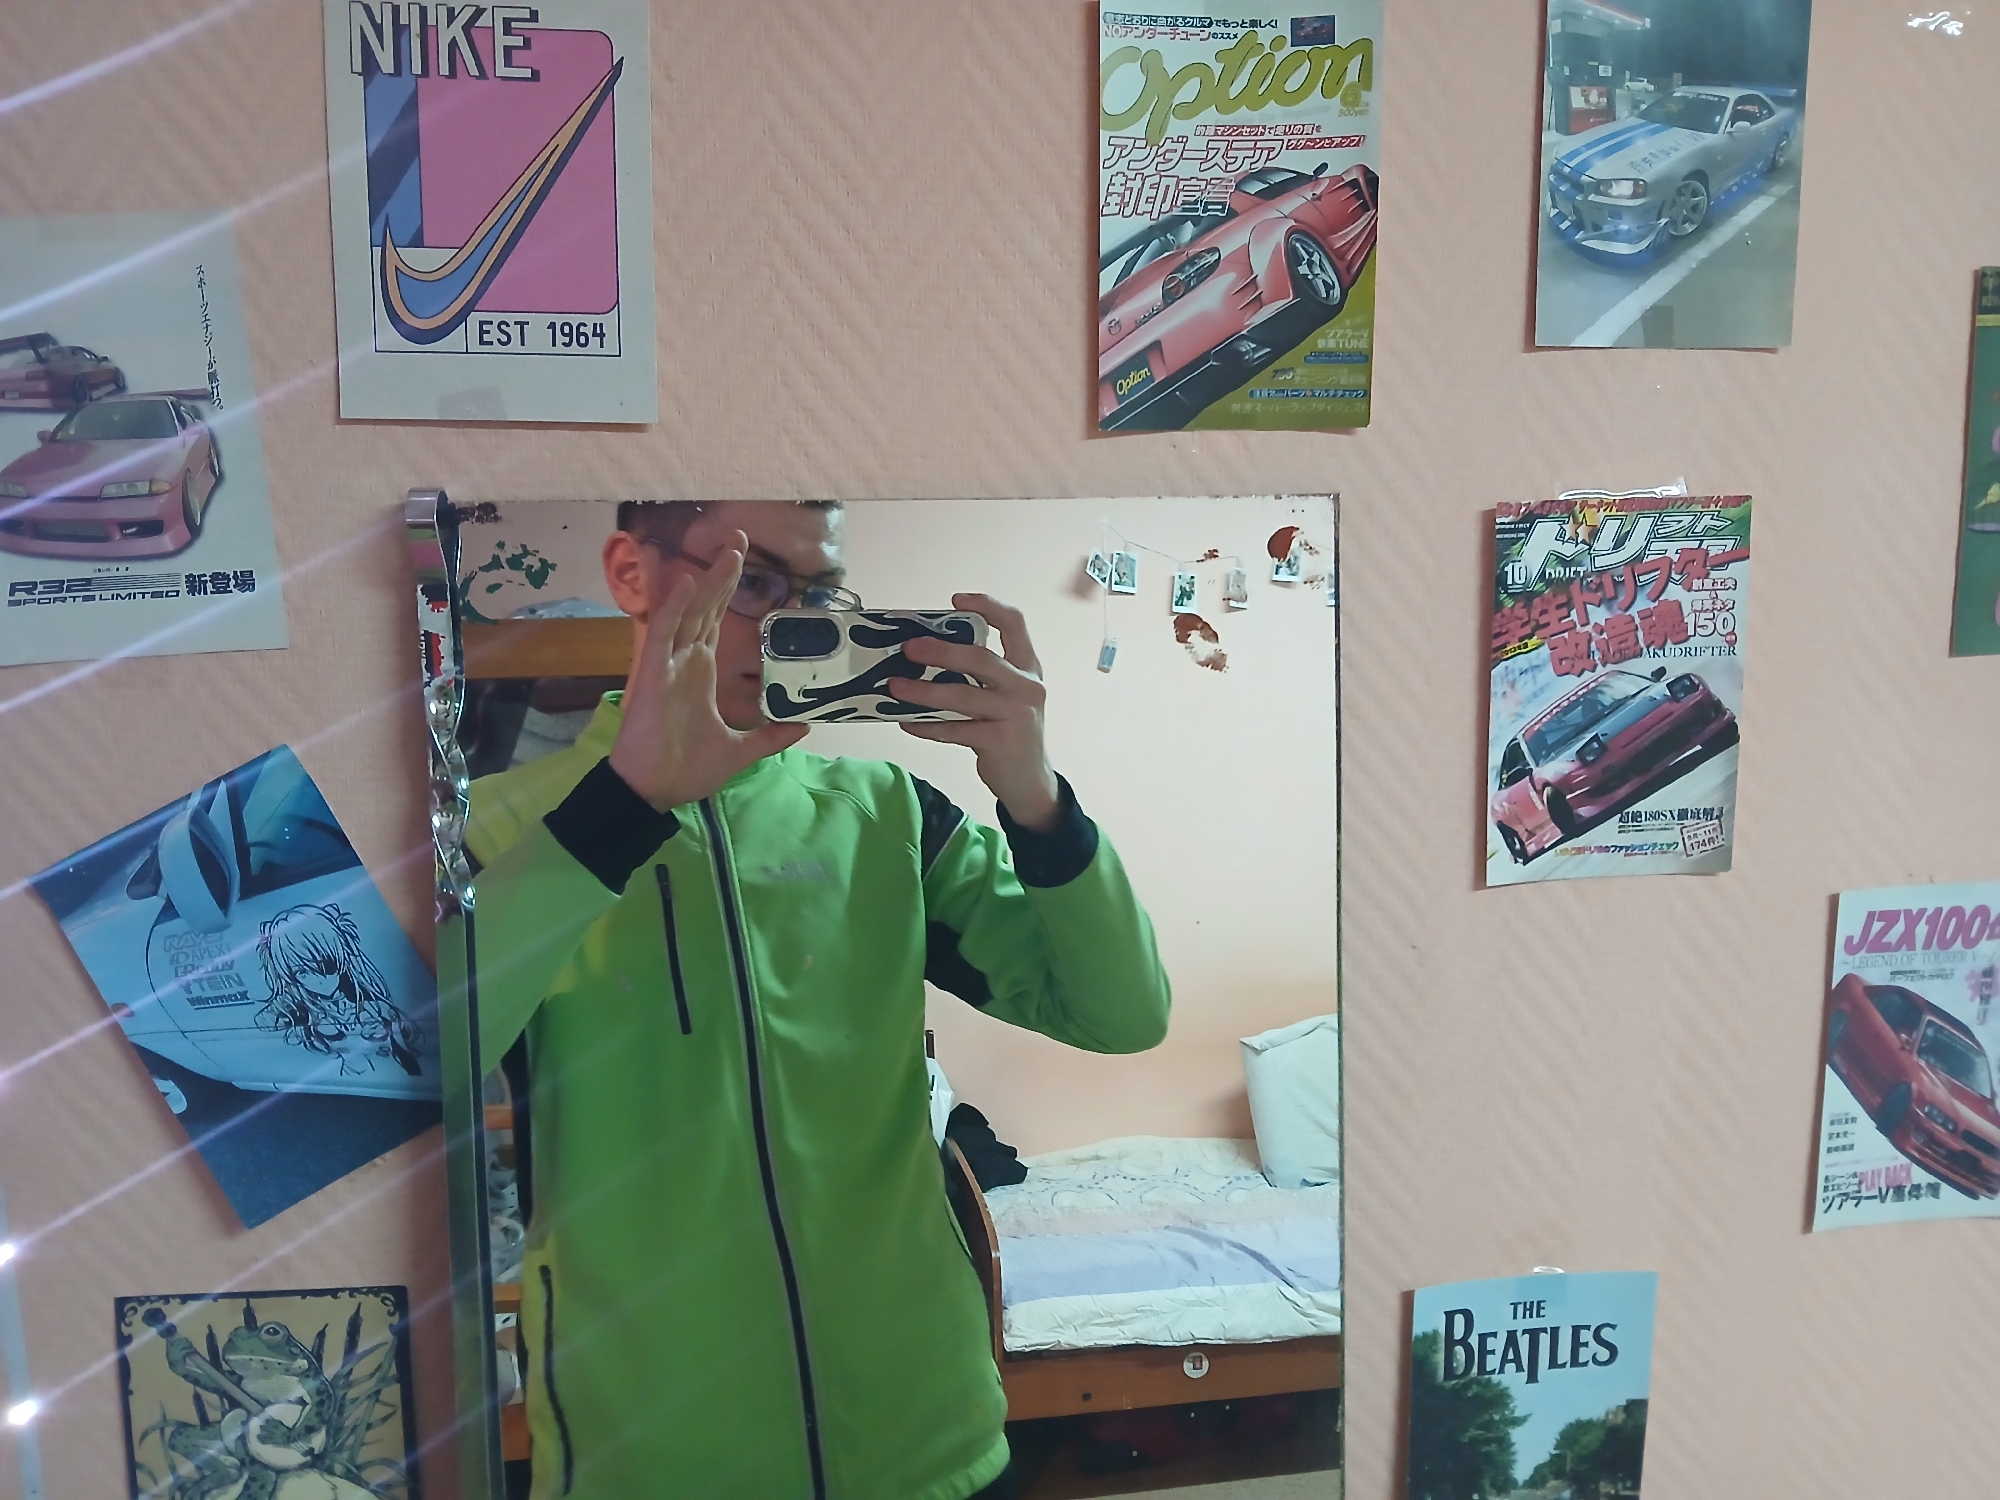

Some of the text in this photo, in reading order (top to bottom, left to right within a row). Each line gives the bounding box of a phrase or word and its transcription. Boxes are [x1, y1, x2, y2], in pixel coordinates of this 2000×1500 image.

[350, 1, 540, 82] NIKE
[478, 320, 606, 348] EST 1964
[1116, 367, 1151, 395] Option
[9, 577, 92, 597] R32
[184, 569, 257, 597] 新登場
[1504, 562, 1528, 586] 10
[8, 589, 181, 608] SPORTS LIMITED
[1684, 611, 1736, 637] 150
[1900, 952, 1918, 966] OF
[1509, 1300, 1547, 1320] THE
[1443, 1308, 1619, 1385] BEATLES
